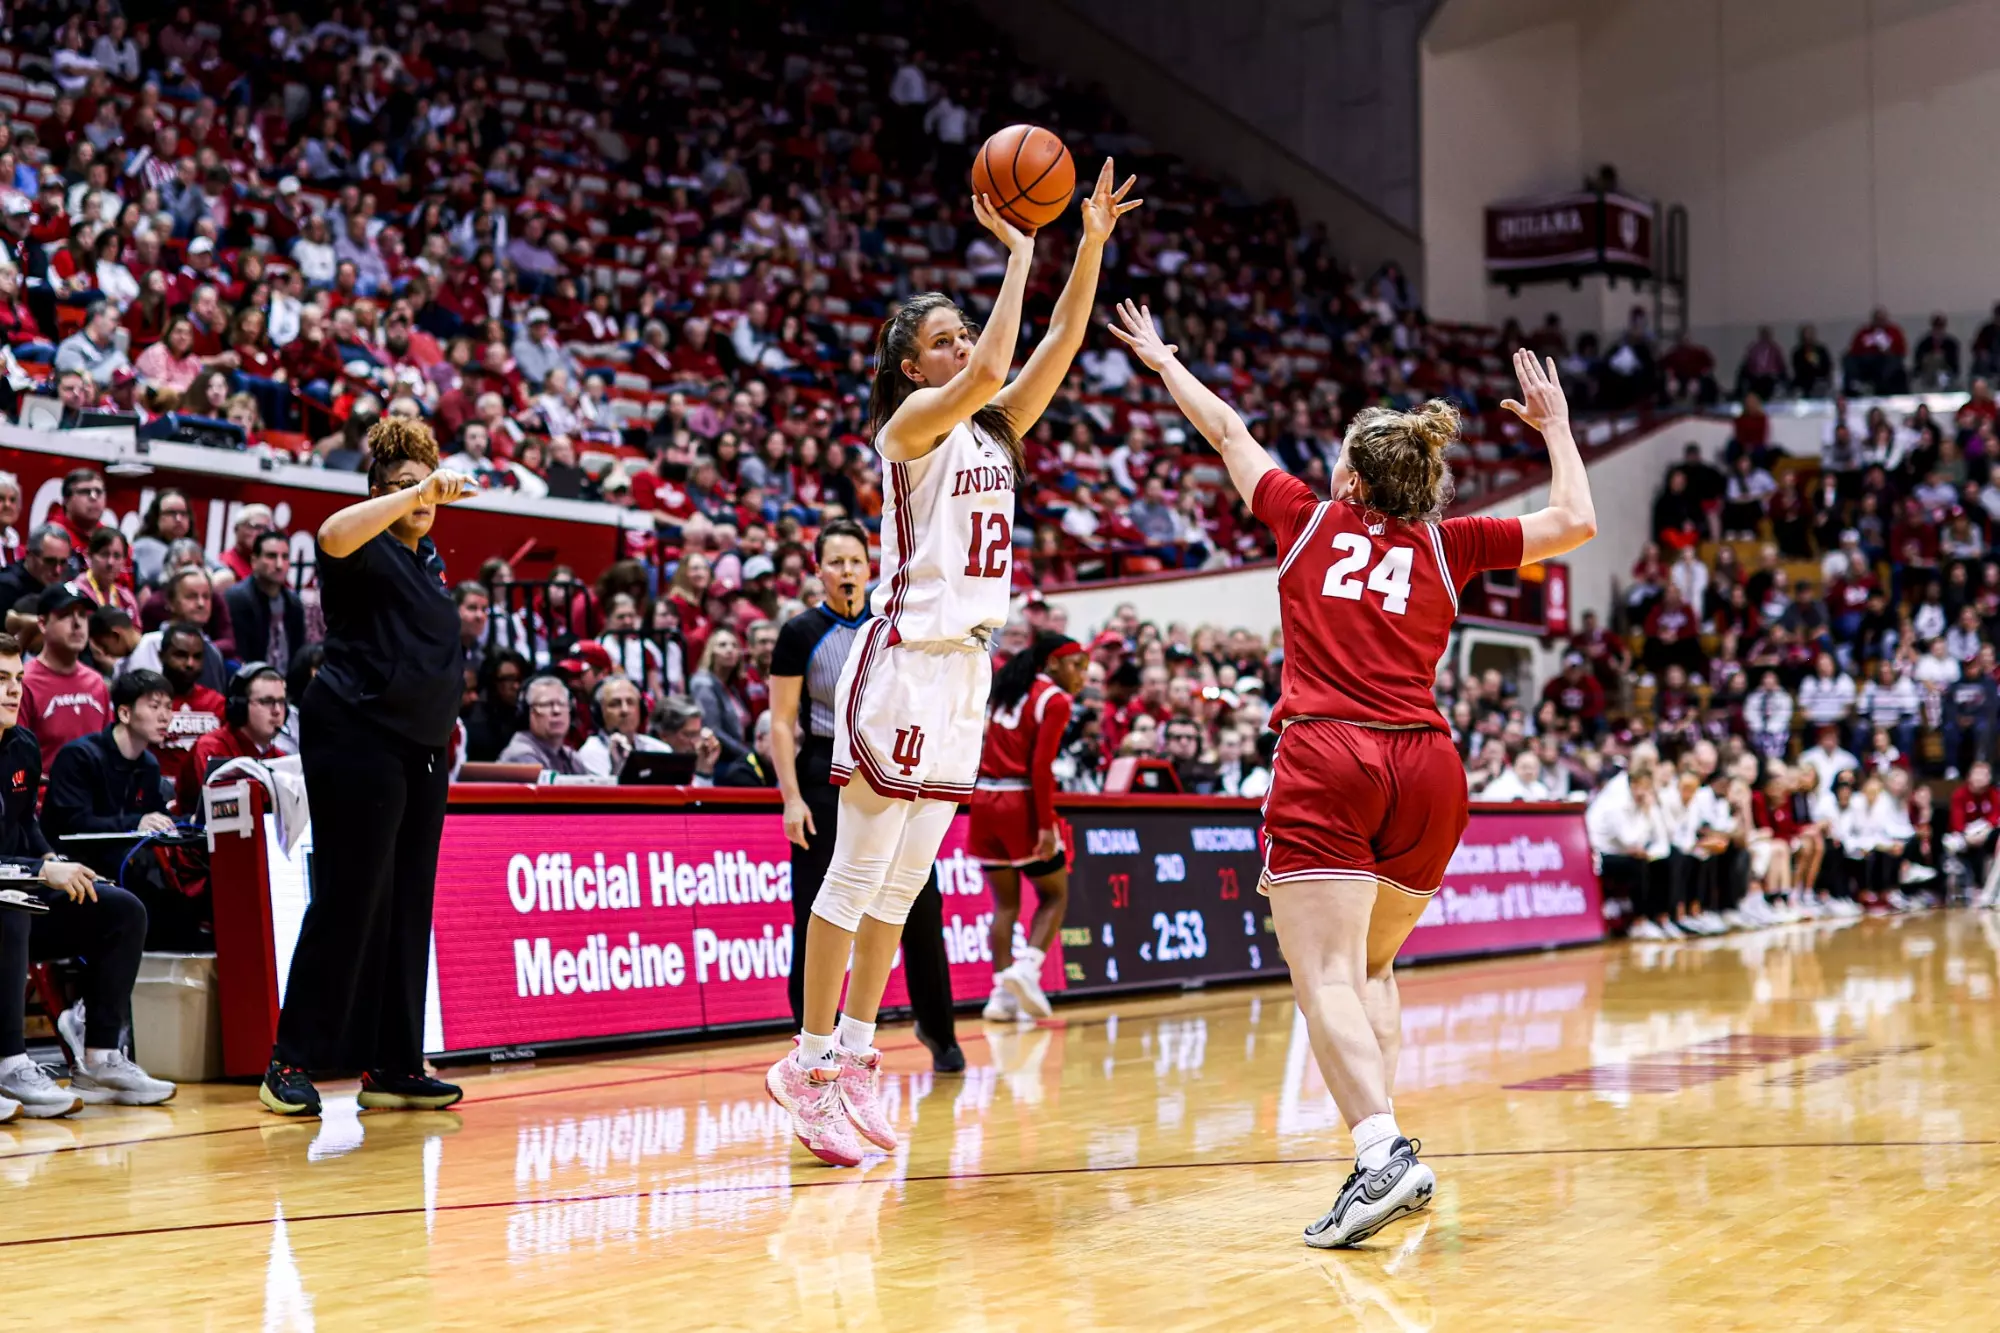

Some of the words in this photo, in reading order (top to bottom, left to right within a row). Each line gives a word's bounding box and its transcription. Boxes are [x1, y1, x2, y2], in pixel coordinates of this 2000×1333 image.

[964, 512, 1011, 578] 12
[1322, 532, 1414, 615] 24
[506, 851, 640, 913] Official
[648, 850, 792, 908] Healthca
[513, 931, 686, 998] Medicine
[697, 924, 793, 987] Provid
[1152, 909, 1208, 962] 2:53
